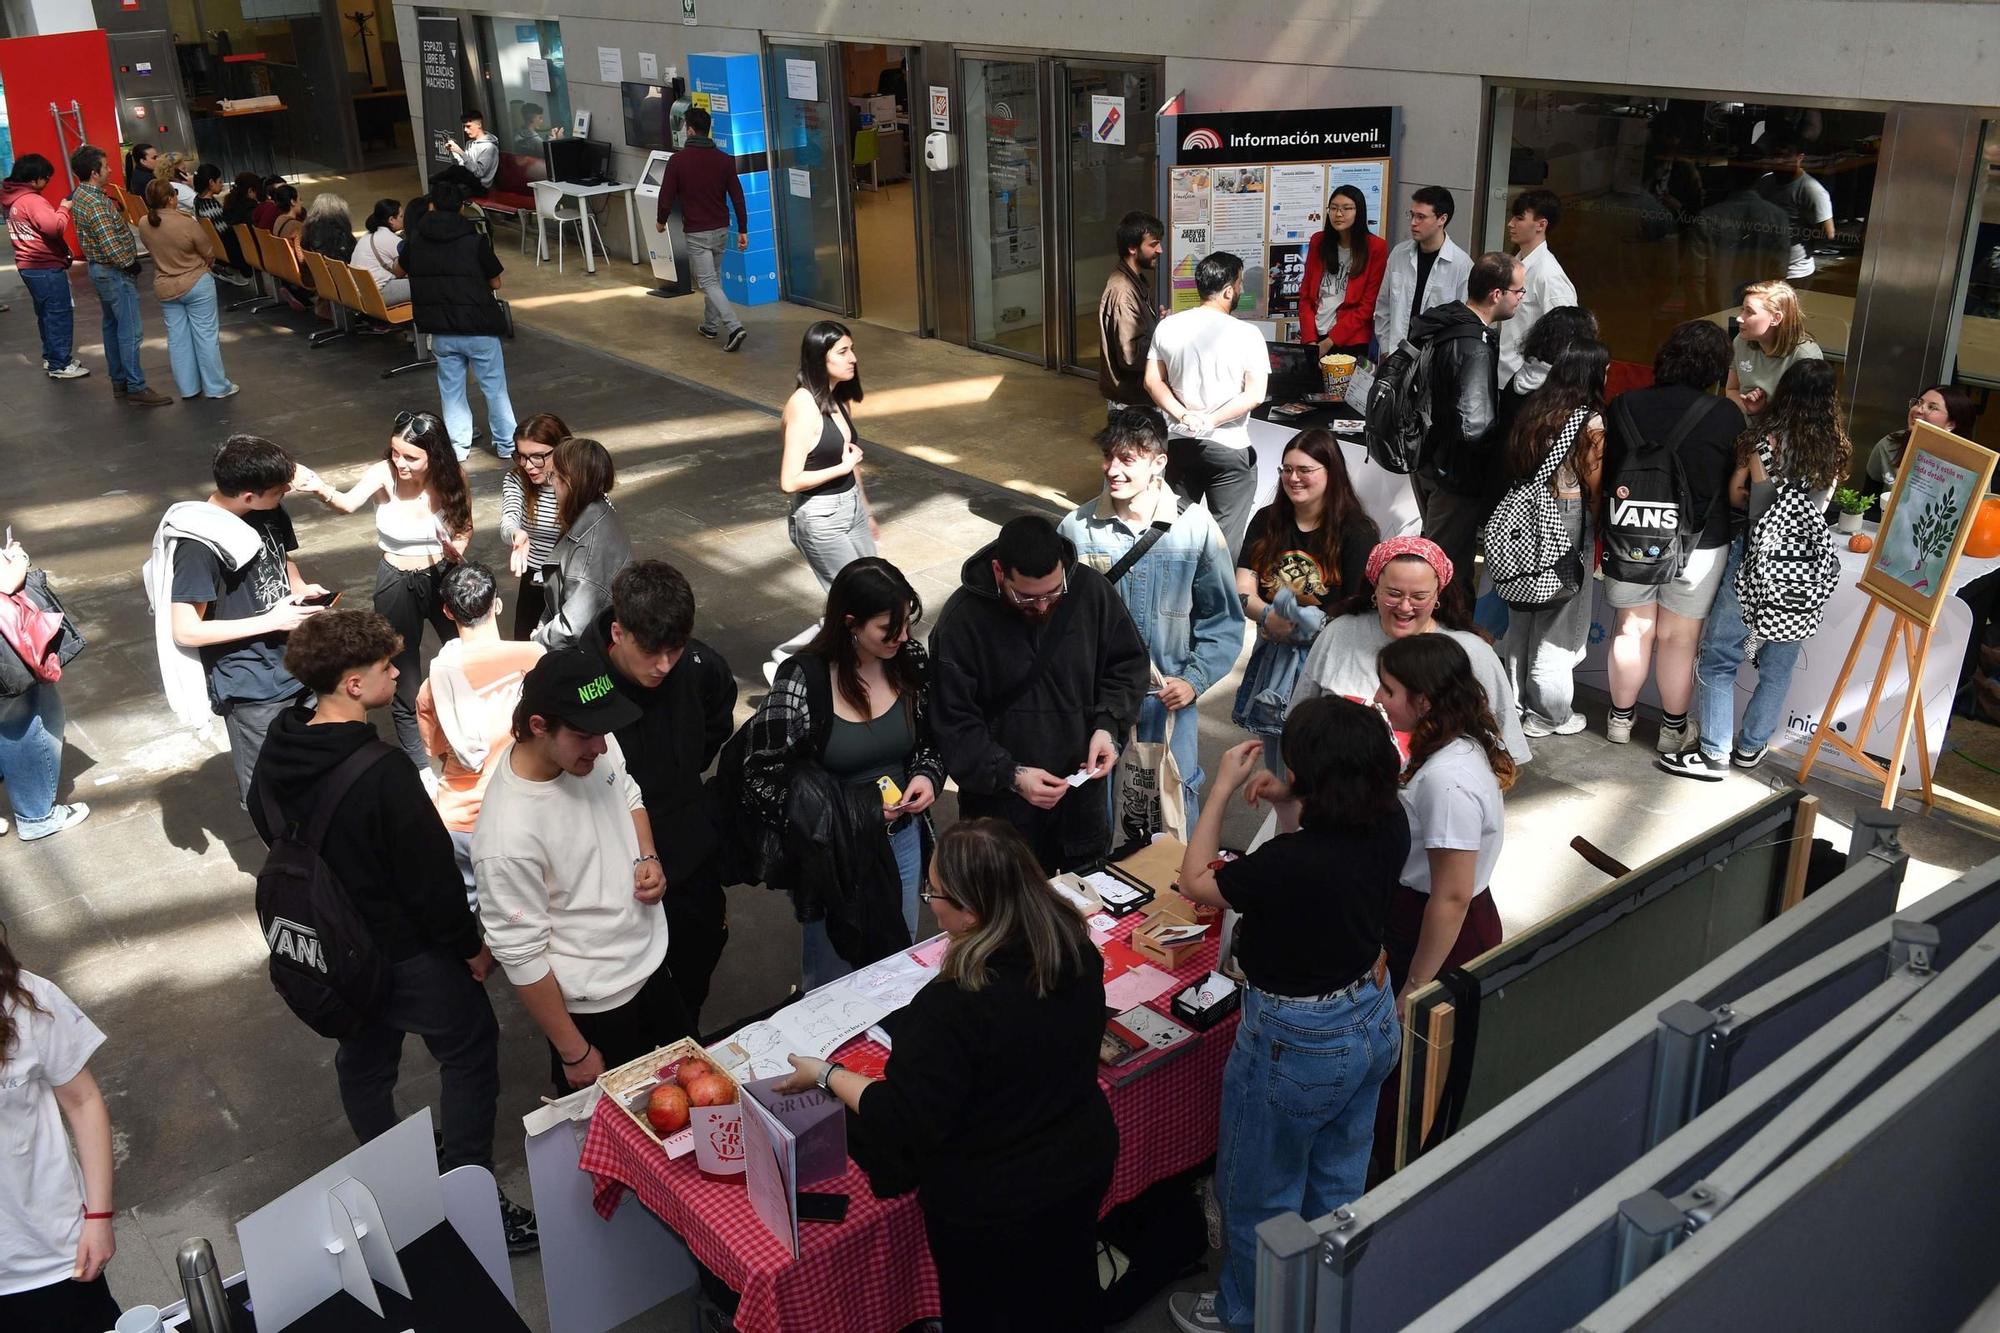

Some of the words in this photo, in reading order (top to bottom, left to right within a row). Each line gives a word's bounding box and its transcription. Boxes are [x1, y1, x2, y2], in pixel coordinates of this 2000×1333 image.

[424, 41, 443, 51] ESPAZO
[425, 53, 438, 64] LIBRE
[439, 54, 446, 64] DE
[425, 65, 454, 77] VIOLENCIAS
[426, 77, 456, 90] MACHISTAS
[1230, 131, 1319, 148] Información
[1324, 128, 1379, 145] xuvenil
[1610, 497, 1679, 530] VANS
